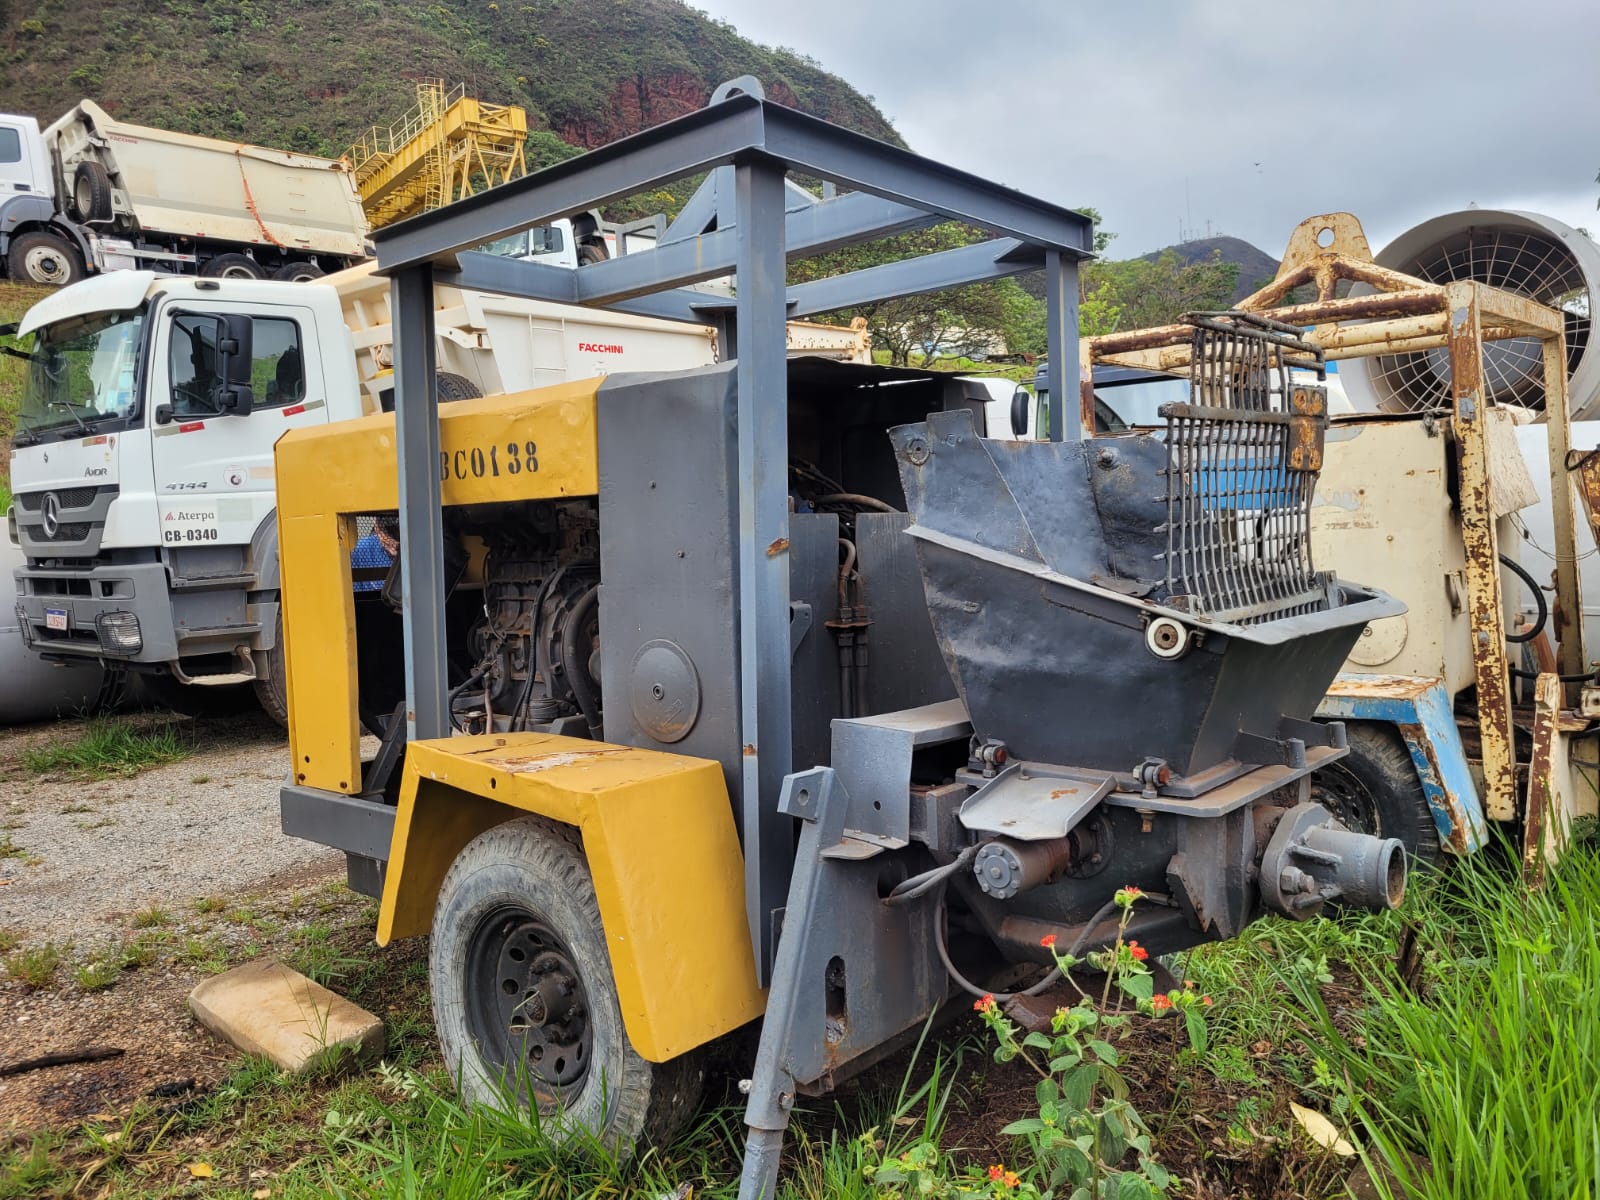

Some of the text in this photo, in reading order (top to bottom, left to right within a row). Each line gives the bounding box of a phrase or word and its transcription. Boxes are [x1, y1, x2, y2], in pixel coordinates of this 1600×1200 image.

[578, 343, 624, 354] FACCHINI
[178, 511, 215, 522] Aterpa
[164, 528, 218, 542] CB-0340
